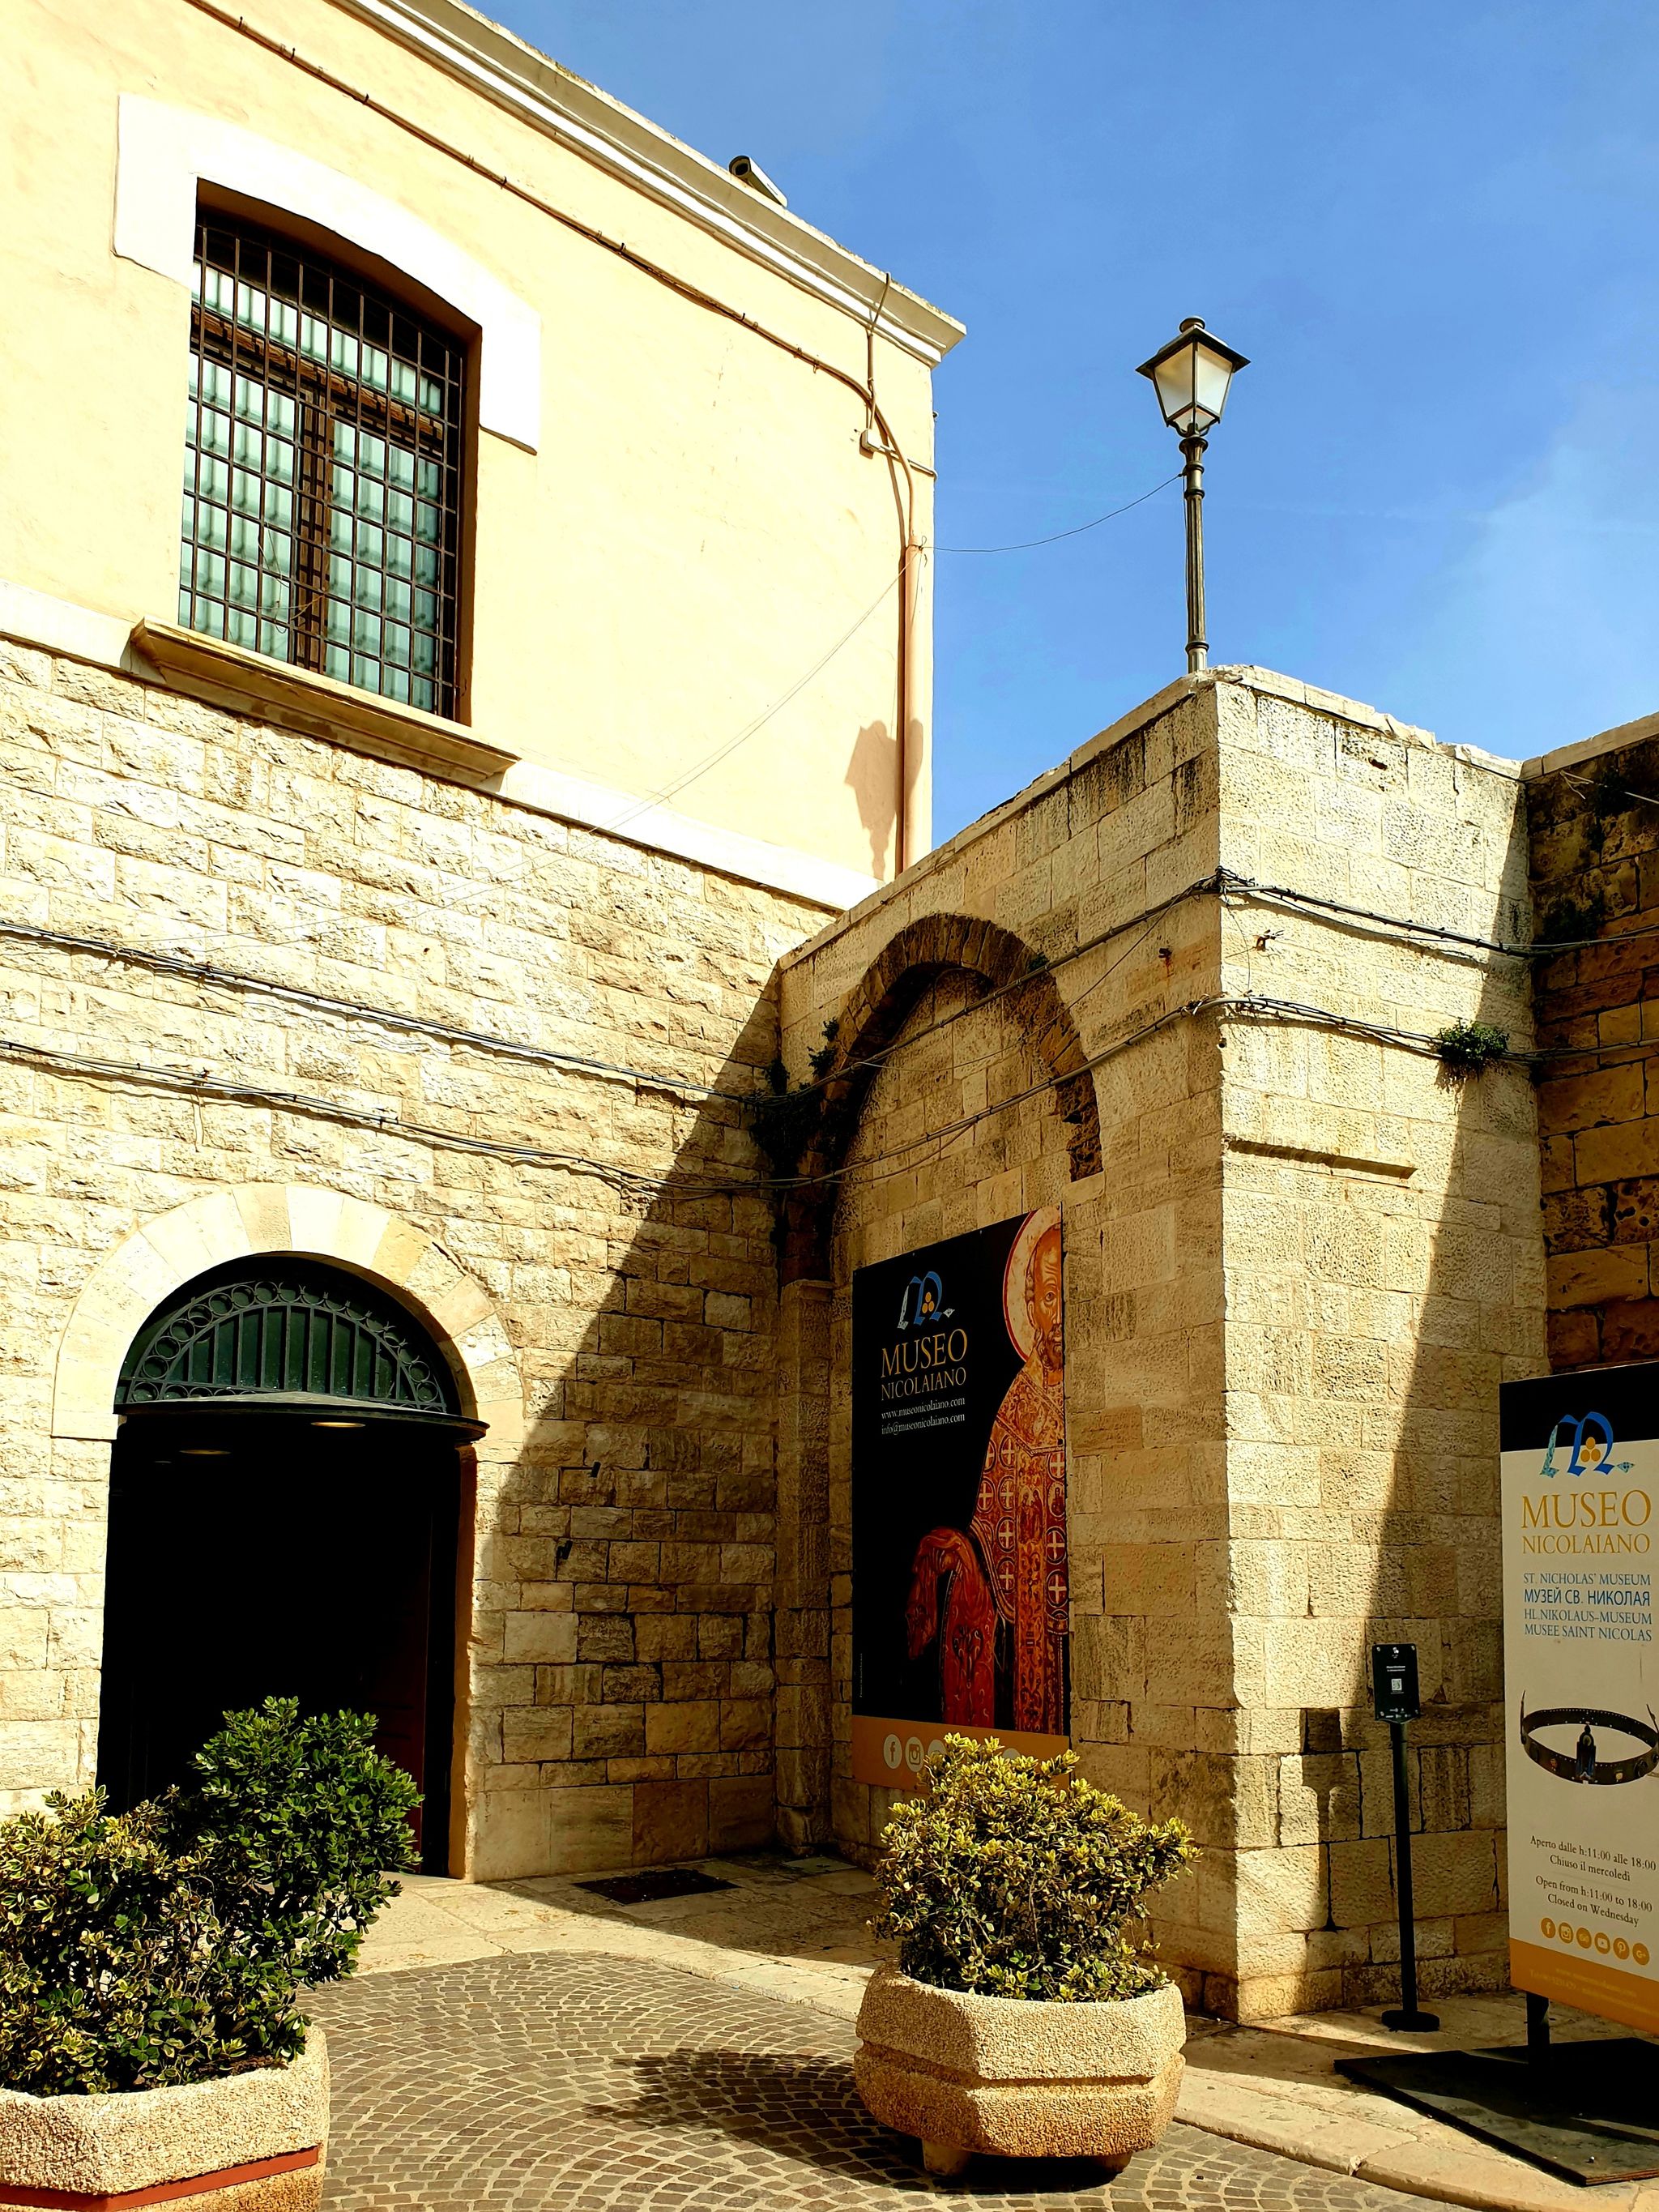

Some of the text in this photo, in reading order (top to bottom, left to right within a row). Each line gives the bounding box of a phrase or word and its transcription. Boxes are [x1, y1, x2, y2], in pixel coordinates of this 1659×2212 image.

[881, 1328, 968, 1378] MUSEO
[881, 1366, 966, 1401] NICOLAIANO
[881, 1397, 966, 1420] www.museonicolaiano.com
[881, 1413, 966, 1436] info@museonicolaiano.com
[1520, 1489, 1652, 1529] MUSEO
[1522, 1533, 1651, 1555] NICOLAIANO
[1524, 1573, 1651, 1586] ST. NICHOLAS' MUSEUM
[1524, 1586, 1651, 1607] МУЗЕЙ СВ. НИКОЛАЯ
[1525, 1624, 1653, 1642] MUSEE SAINT NICOLAS
[1530, 1835, 1657, 1871] Aperto dalle h:11:00 alle 18:00
[1550, 1854, 1578, 1869] Chiuso
[1580, 1861, 1586, 1872] il
[1535, 1875, 1653, 1912] Open from h:11:00 to 18:00
[1547, 1893, 1640, 1928] Closed on Wednesday
